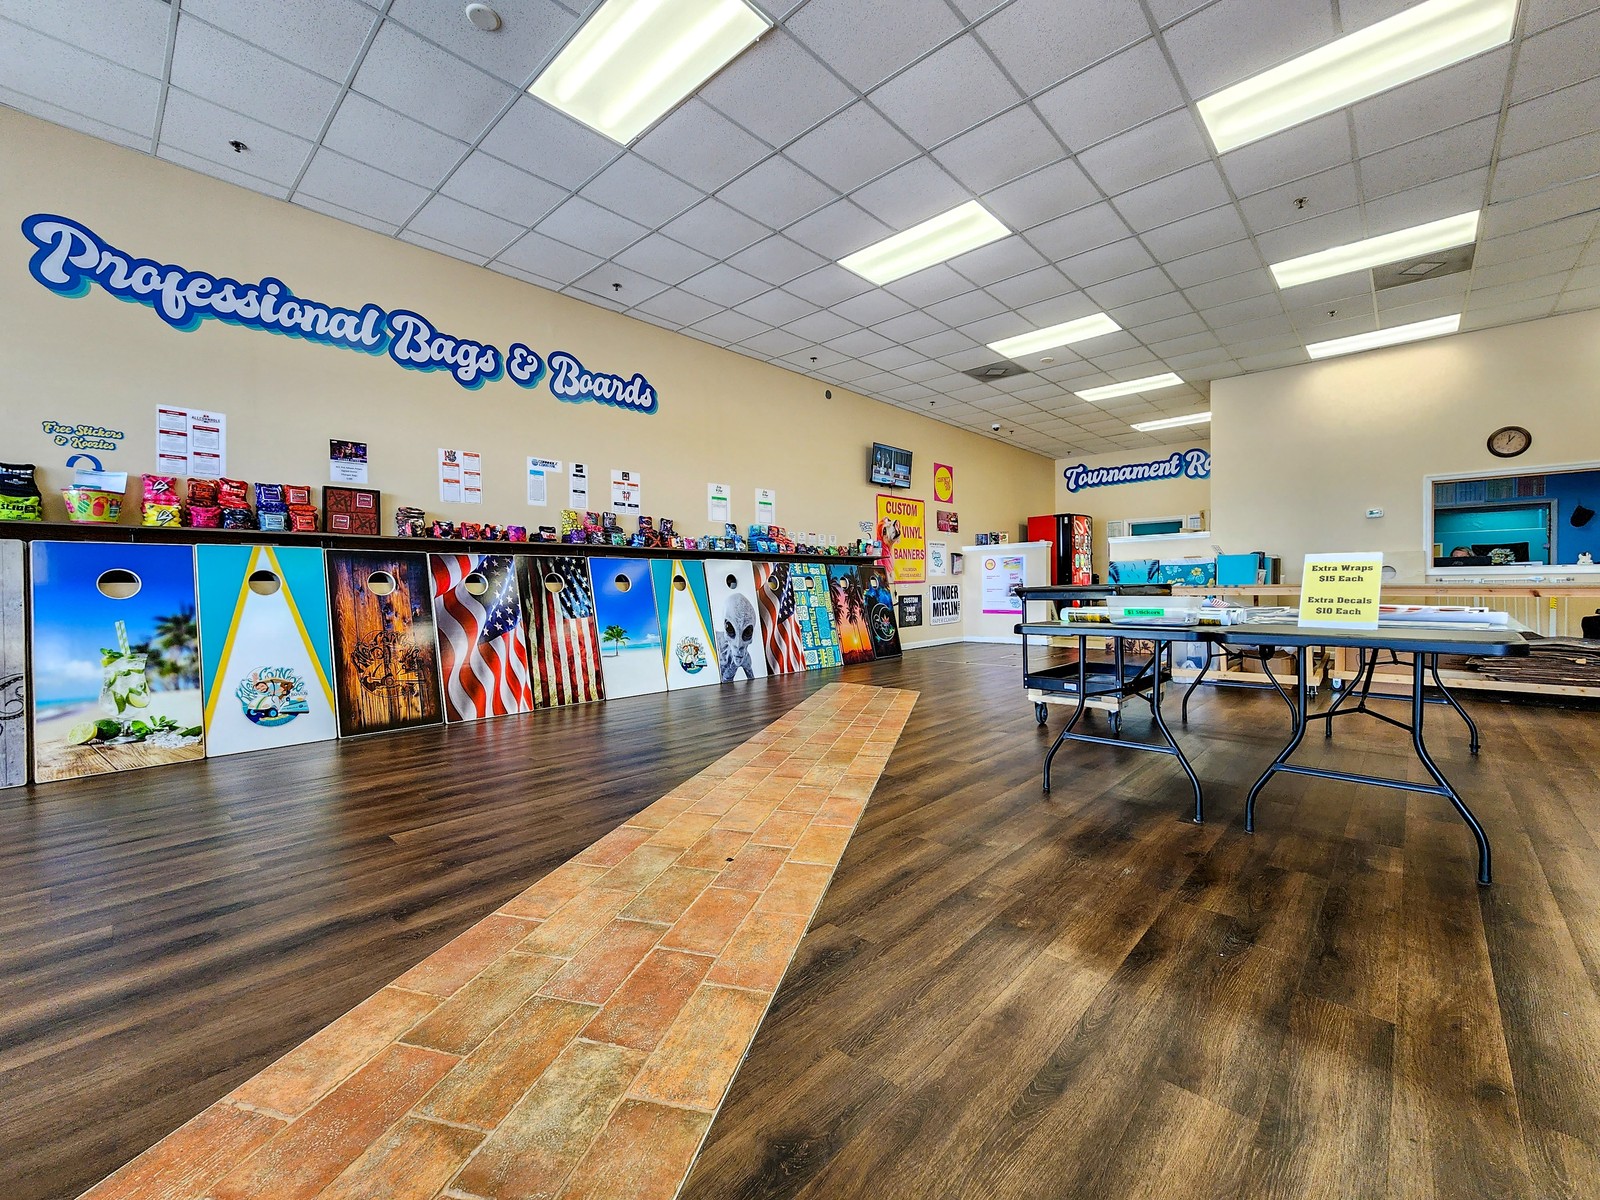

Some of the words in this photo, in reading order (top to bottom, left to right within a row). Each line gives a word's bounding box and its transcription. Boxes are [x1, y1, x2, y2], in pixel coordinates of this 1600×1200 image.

[26, 217, 386, 350] Professional
[389, 312, 499, 386] Bags
[506, 346, 541, 384] &
[550, 353, 656, 411] Boards
[43, 421, 73, 434] Free
[75, 425, 124, 439] Stickers
[54, 435, 67, 446] &
[70, 436, 116, 450] Koozies
[1065, 453, 1181, 491] Tournament
[885, 500, 917, 516] CUSTOM
[902, 526, 922, 539] VINYL
[894, 548, 925, 560] BANNERS
[1341, 564, 1374, 572] Wraps
[903, 596, 918, 604] CUSTOM
[932, 585, 958, 600] DUNDER
[1335, 607, 1361, 615] Each
